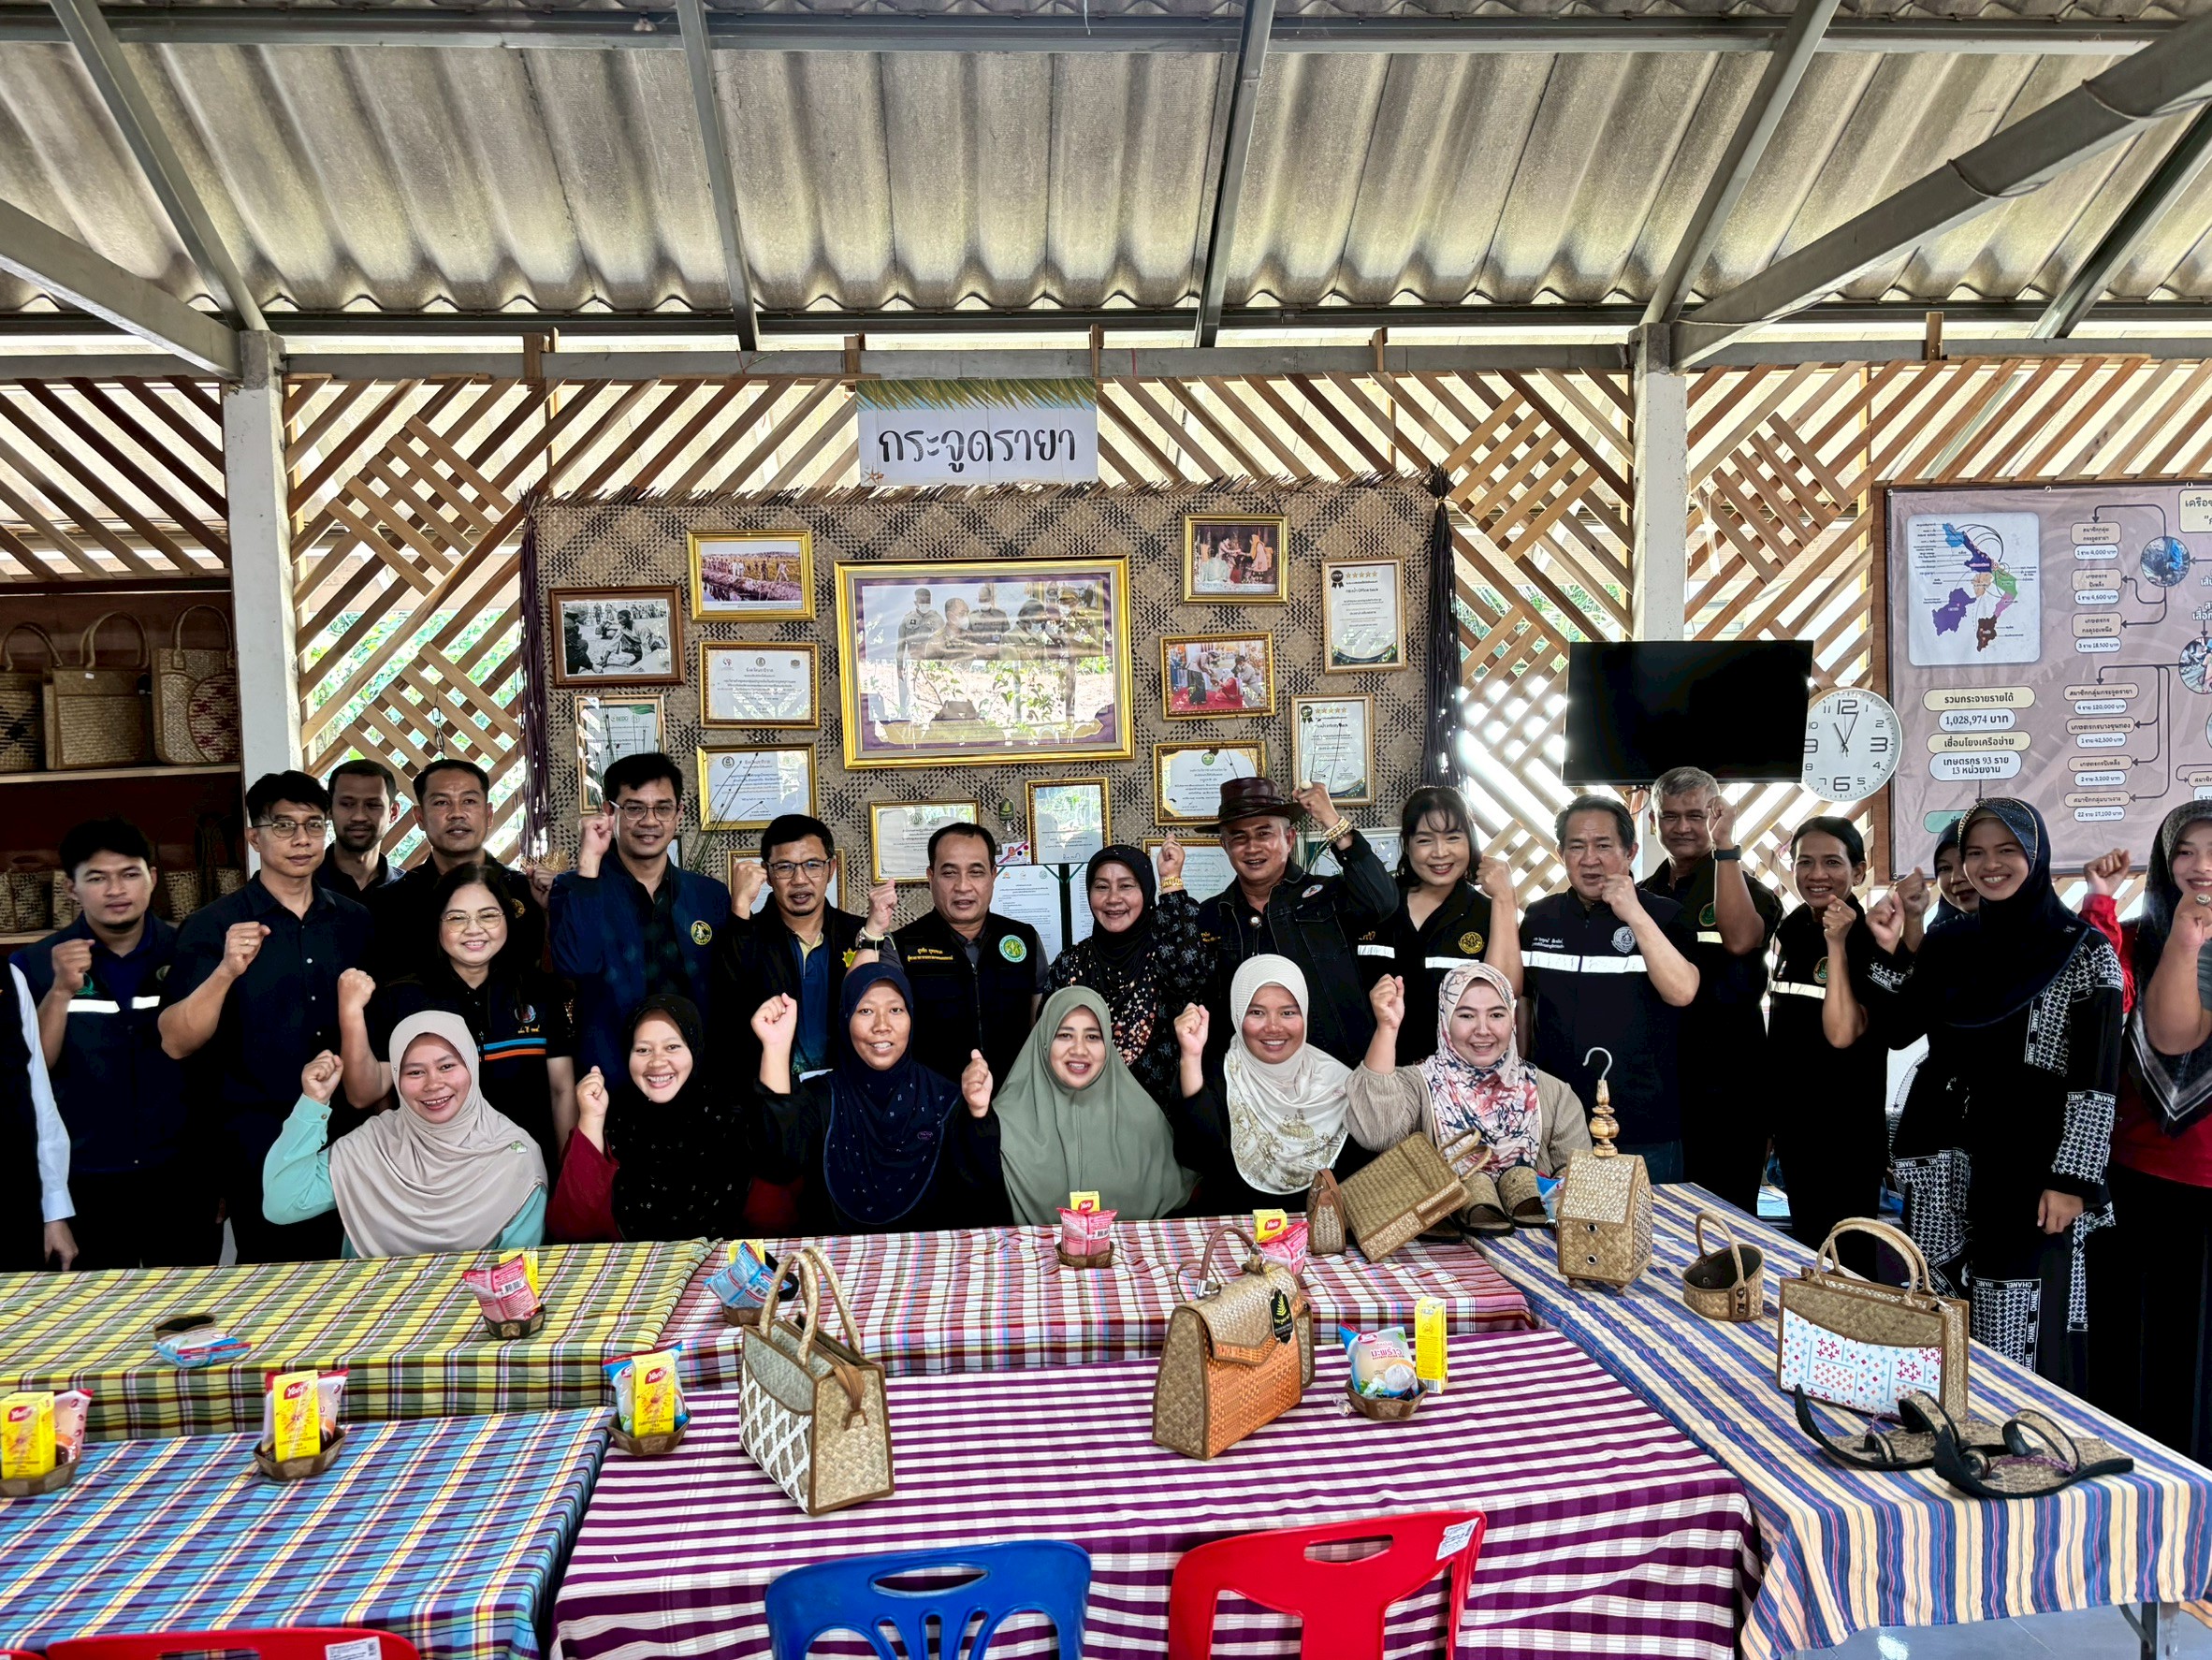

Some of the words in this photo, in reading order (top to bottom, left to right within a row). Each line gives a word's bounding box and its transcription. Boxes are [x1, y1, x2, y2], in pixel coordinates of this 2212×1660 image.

[879, 429, 1076, 473] กระจูดรายา
[1944, 692, 2014, 704] รวมกระจายรายได้
[1823, 706, 1831, 714] 11
[1837, 699, 1858, 715] 12
[1865, 704, 1869, 712] 1
[1875, 720, 1885, 728] 2
[1945, 716, 1987, 726] 1,028,974
[1989, 715, 2009, 724] บาท
[1870, 736, 1888, 752] 3
[1944, 735, 2015, 748] เชื่อมโยงเครือข่าย
[1872, 761, 1881, 769] 4
[1943, 757, 1980, 766] เกษตรกร
[1982, 756, 1992, 765] 93
[1994, 756, 2009, 764] ราย
[1805, 763, 1813, 771] 8
[1952, 766, 1960, 775] 13
[1962, 764, 2001, 775] หน่วยงาน
[1833, 776, 1851, 792] 6
[1856, 777, 1866, 785] 5
[2030, 1010, 2040, 1033] CHANEL
[2004, 1281, 2032, 1289] CHANEL
[2030, 1288, 2039, 1312] CHANEL
[2027, 1320, 2036, 1344] CHANEL
[1371, 1347, 1403, 1357] มะพร้าว
